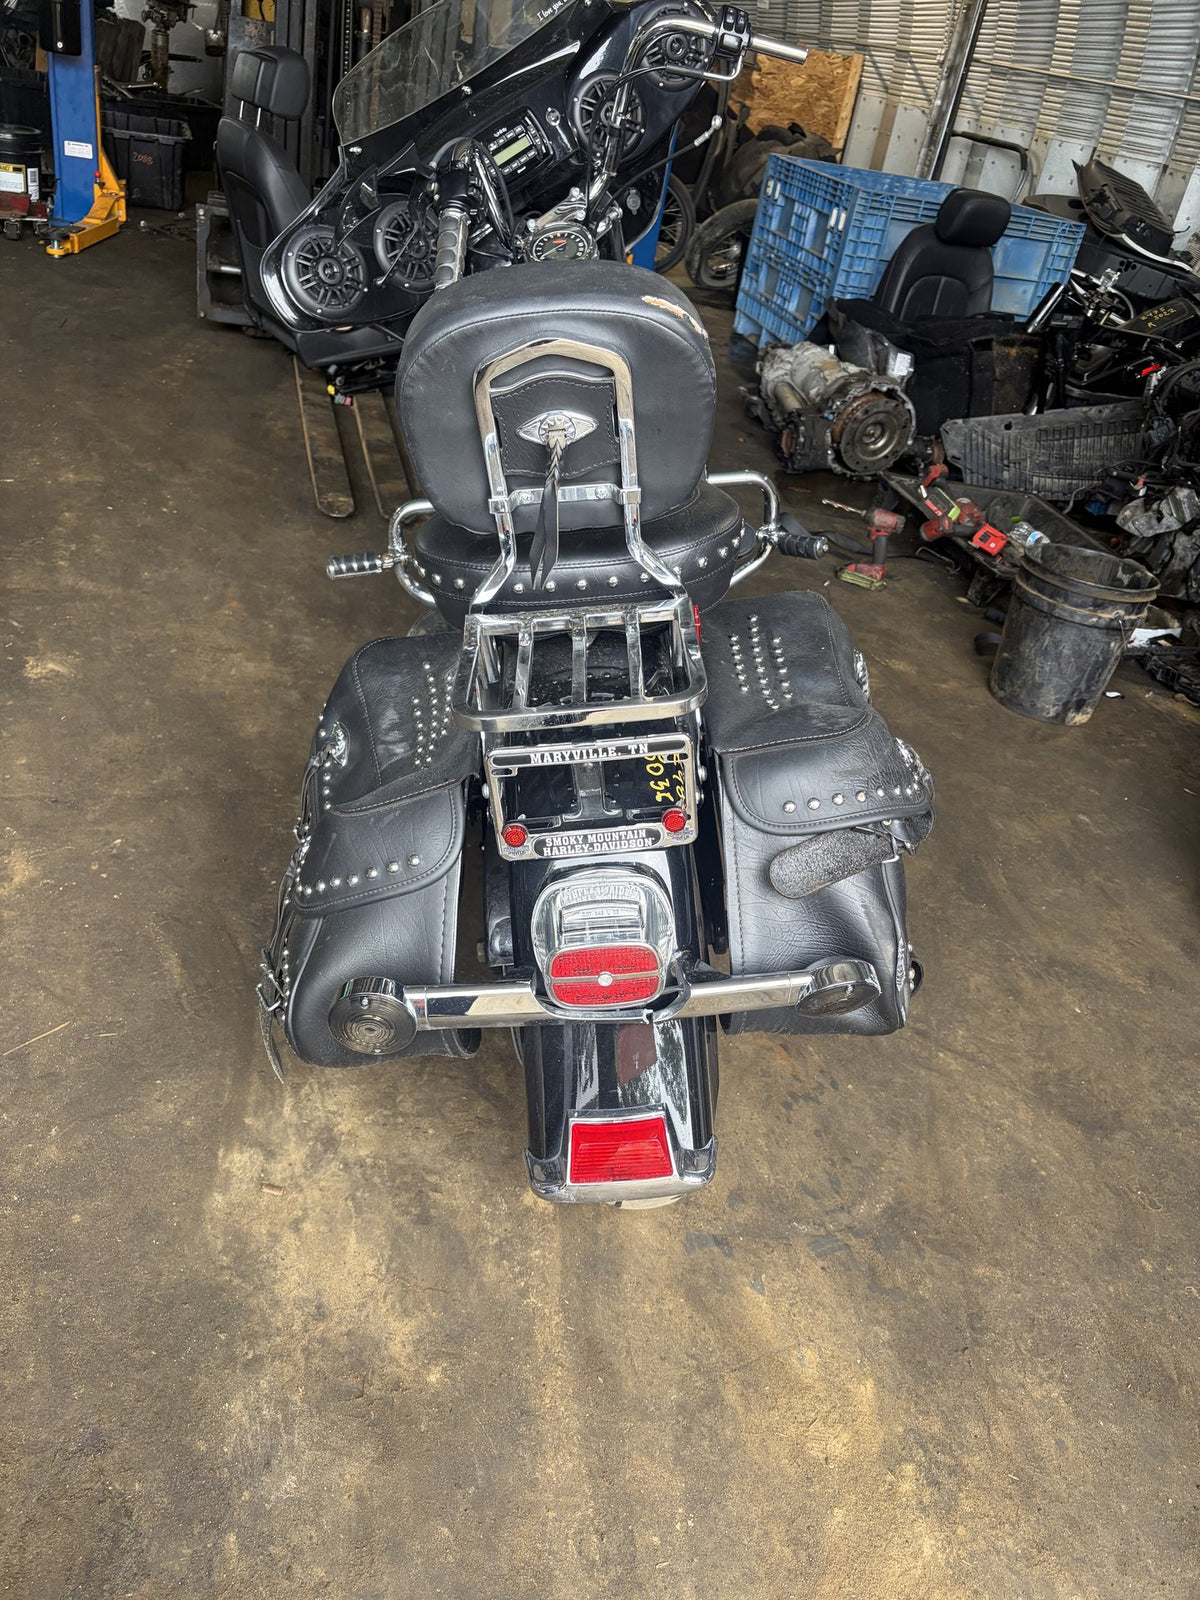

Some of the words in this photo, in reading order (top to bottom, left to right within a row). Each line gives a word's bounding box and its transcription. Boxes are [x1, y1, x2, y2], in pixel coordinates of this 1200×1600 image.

[541, 8, 554, 18] love
[627, 743, 649, 755] TN
[545, 836, 585, 847] SMOKY
[587, 829, 647, 843] MOUNTAIN
[542, 838, 653, 857] HARLEY-DAVIDSON
